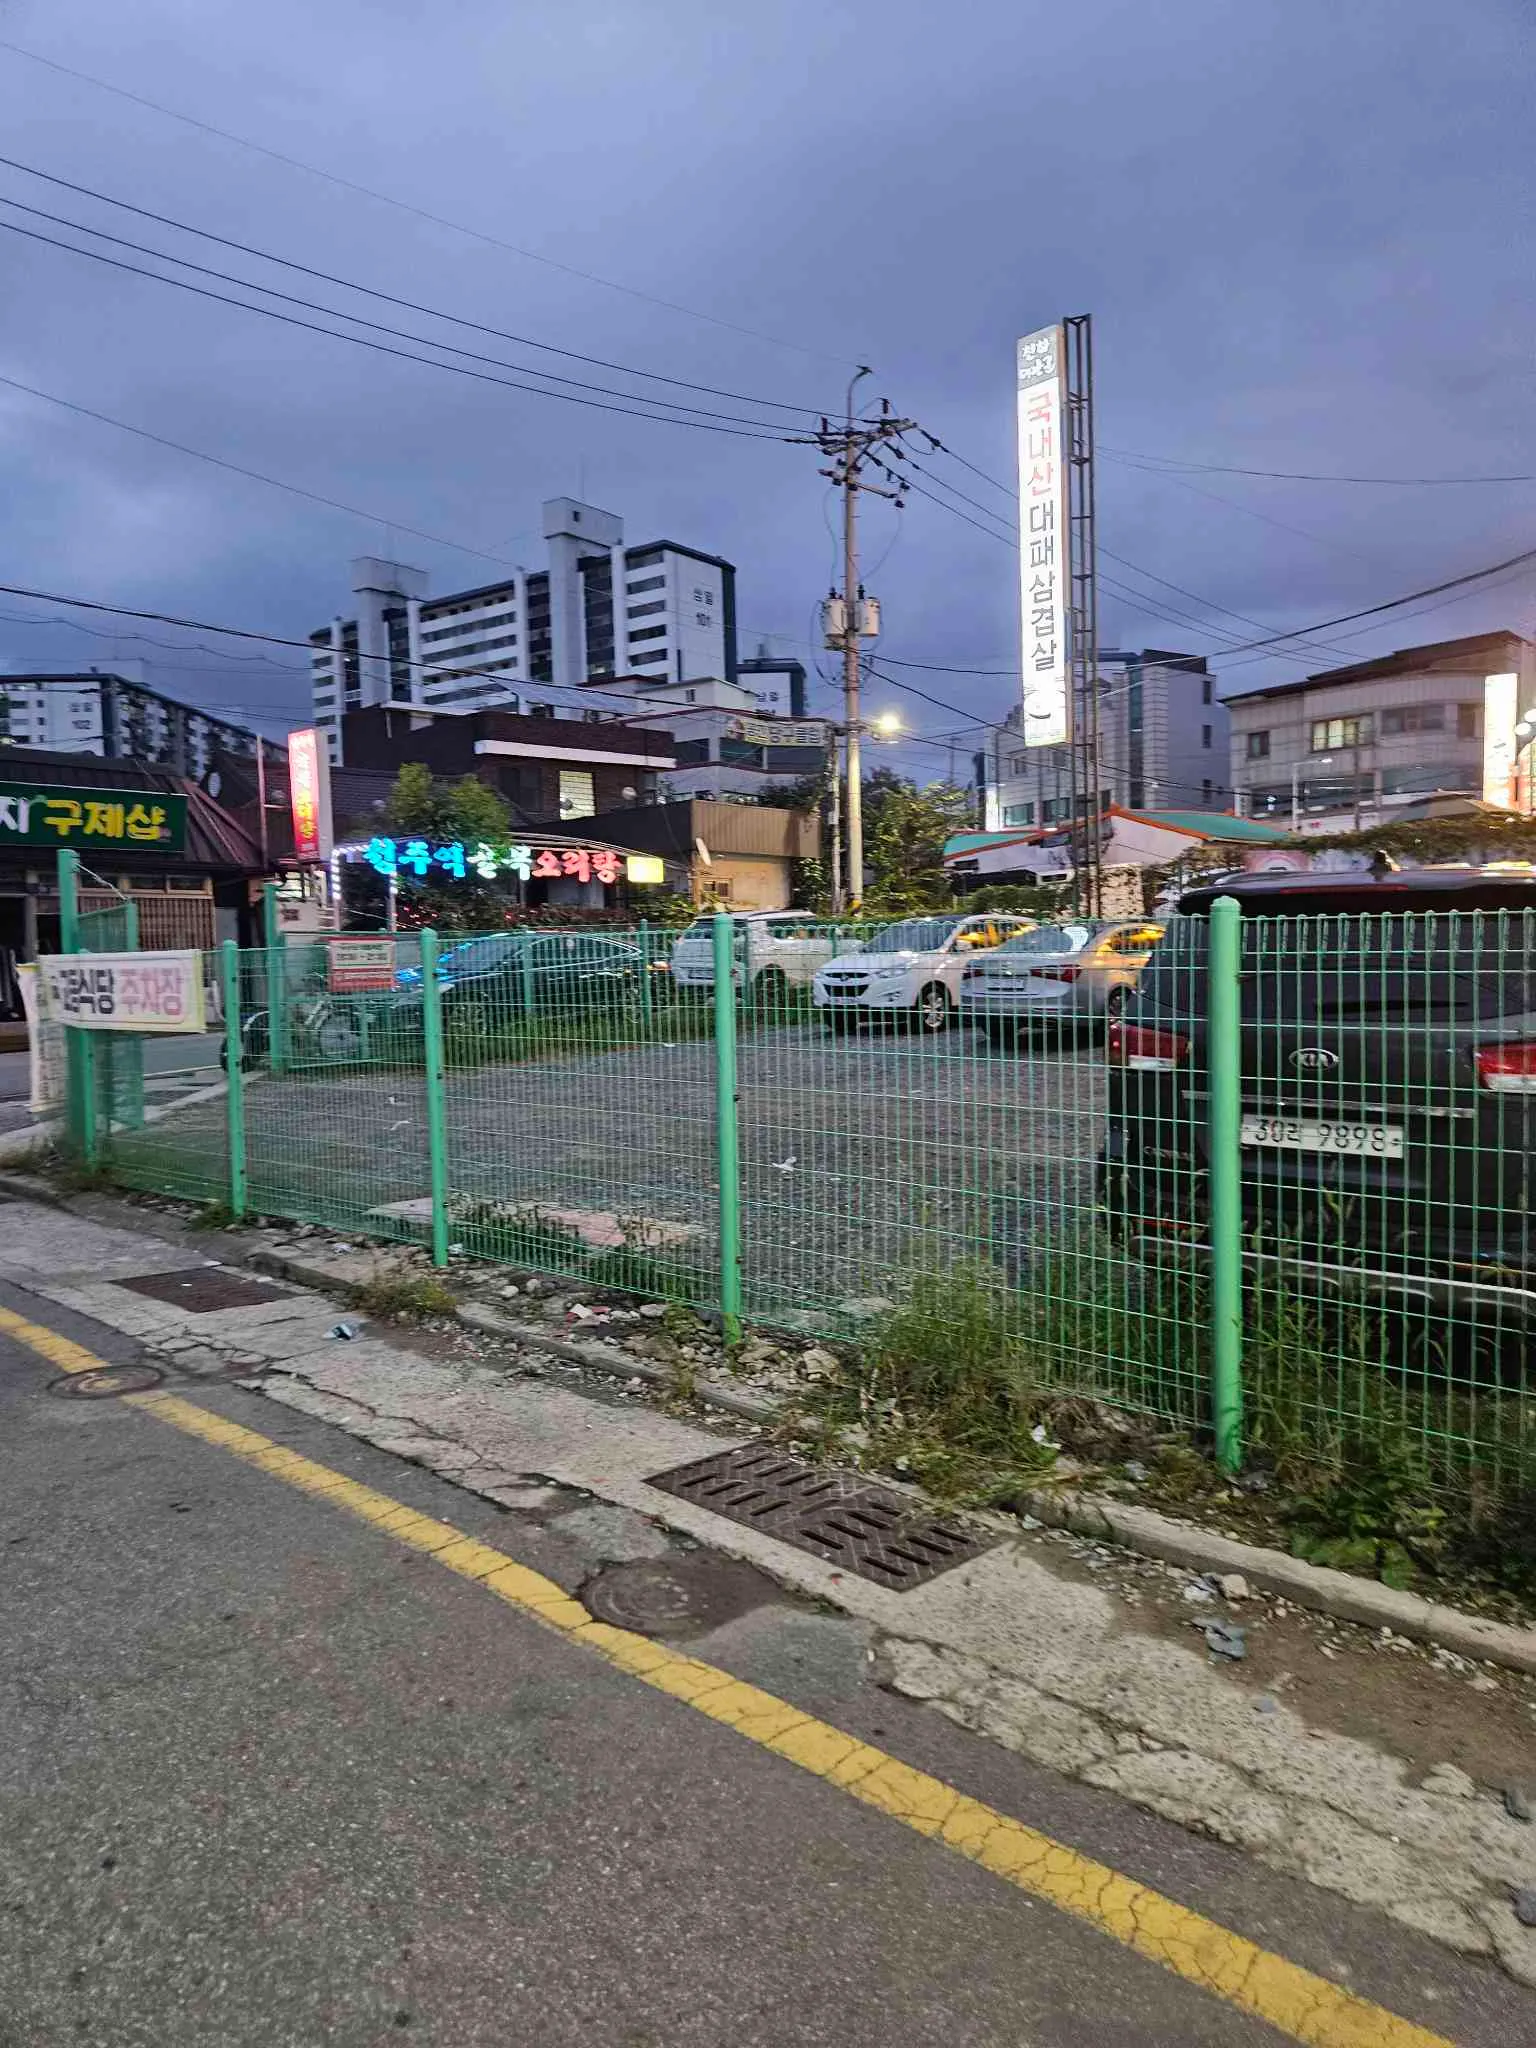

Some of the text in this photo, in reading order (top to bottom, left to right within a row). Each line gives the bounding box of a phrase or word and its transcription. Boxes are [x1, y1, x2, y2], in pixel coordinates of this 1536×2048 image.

[1027, 391, 1053, 497] 국내산
[1028, 499, 1057, 672] 대패삼겹살
[43, 799, 166, 841] 구제샵
[120, 966, 183, 1016] 주차장
[1317, 1122, 1386, 1152] 9898
